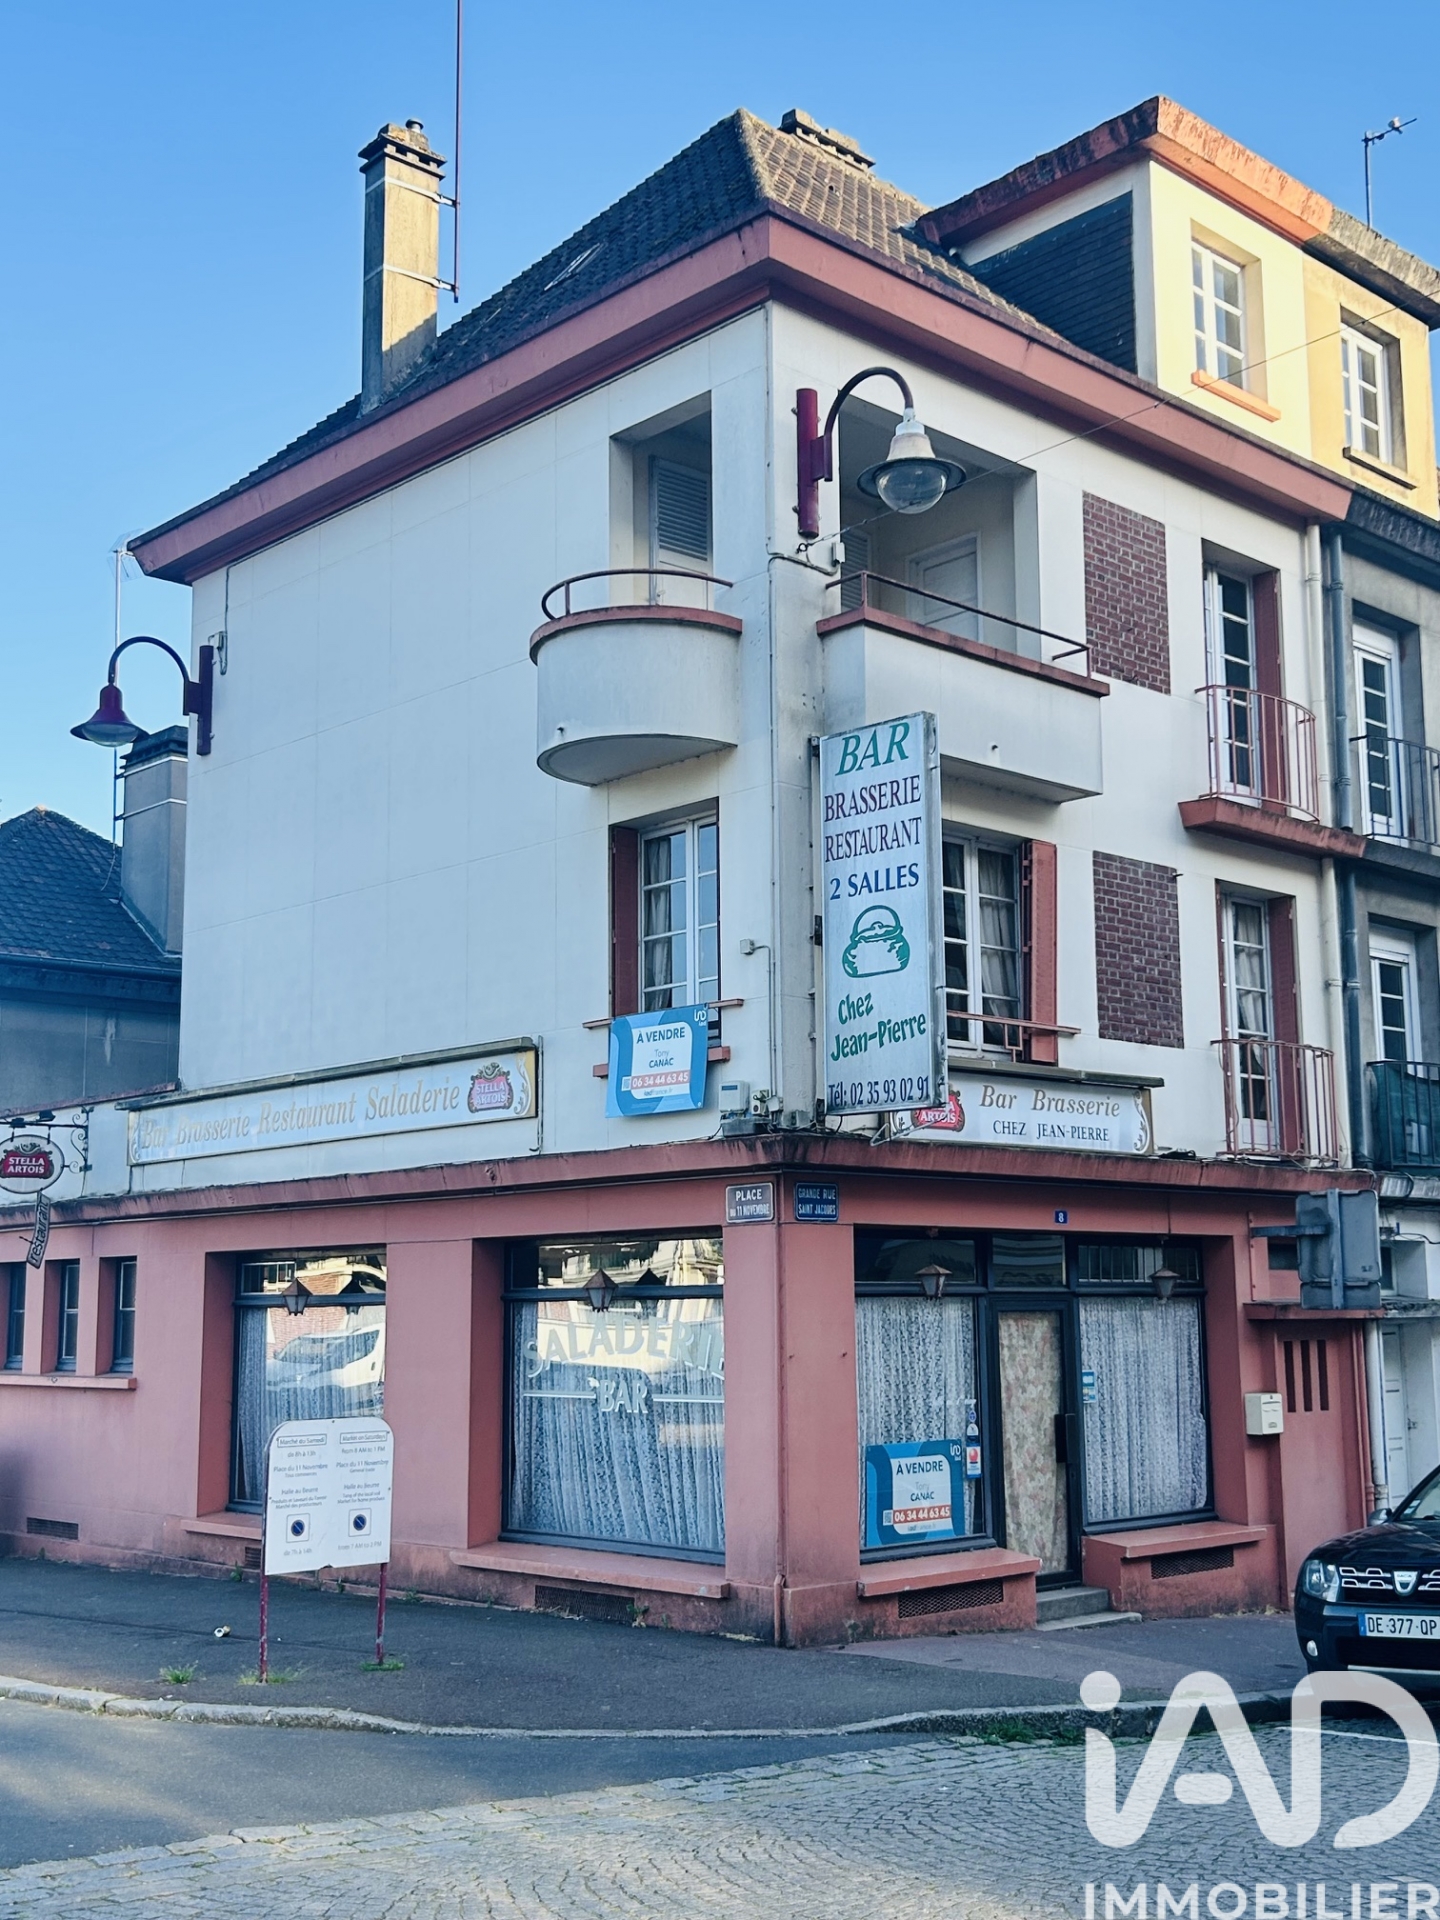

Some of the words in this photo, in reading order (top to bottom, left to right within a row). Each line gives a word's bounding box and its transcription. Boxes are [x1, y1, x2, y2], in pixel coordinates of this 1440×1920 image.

[835, 722, 910, 776] BAR
[824, 775, 921, 822] BRASSERIE
[825, 817, 922, 862] RESTAURANT
[830, 878, 841, 900] 2
[848, 863, 919, 899] SALLES
[838, 992, 874, 1025] Chez
[636, 1030, 644, 1044] À
[646, 1027, 685, 1042] VENDRE
[830, 1013, 926, 1061] Jean-Pierre
[654, 1048, 669, 1058] Tony
[649, 1058, 674, 1068] CANAC
[632, 1077, 642, 1087] 06
[644, 1076, 654, 1086] 34
[655, 1075, 665, 1085] 44
[667, 1073, 676, 1083] 63
[678, 1072, 688, 1082] 45
[475, 1082, 505, 1093] STELLA
[828, 1081, 847, 1107] Tél:
[850, 1082, 863, 1106] 02
[867, 1081, 879, 1104] 35
[884, 1079, 896, 1103] 93
[901, 1078, 913, 1101] 02
[917, 1076, 929, 1100] 91
[475, 1093, 506, 1105] ARTOIS
[979, 1084, 1017, 1110] Bar
[1031, 1089, 1120, 1117] Brasserie
[141, 1119, 168, 1149] Bar
[176, 1107, 250, 1145] Brasserie
[257, 1092, 357, 1135] Restaurant
[365, 1076, 459, 1121] Saladerie
[993, 1120, 1027, 1136] CHEZ
[1036, 1123, 1110, 1141] JEAN-PIERRE
[8, 1157, 45, 1165] STELLA
[7, 1165, 45, 1174] ARTOIS
[735, 1189, 762, 1201] PLACE
[798, 1188, 820, 1199] GRANDE
[822, 1189, 836, 1199] RUE
[737, 1205, 742, 1216] 11
[743, 1203, 769, 1216] NOVEMBRE
[798, 1204, 813, 1214] SAINT
[814, 1204, 836, 1215] JACQUES
[1058, 1212, 1064, 1223] 8
[30, 1200, 49, 1263] restaurant
[601, 1379, 648, 1413] BAR
[896, 1461, 903, 1475] À
[905, 1460, 943, 1474] VENDRE
[910, 1491, 935, 1501] CANAC
[894, 1511, 905, 1521] 06
[907, 1510, 916, 1520] 34
[918, 1509, 928, 1519] 44
[929, 1508, 939, 1517] 63
[940, 1506, 950, 1516] 45
